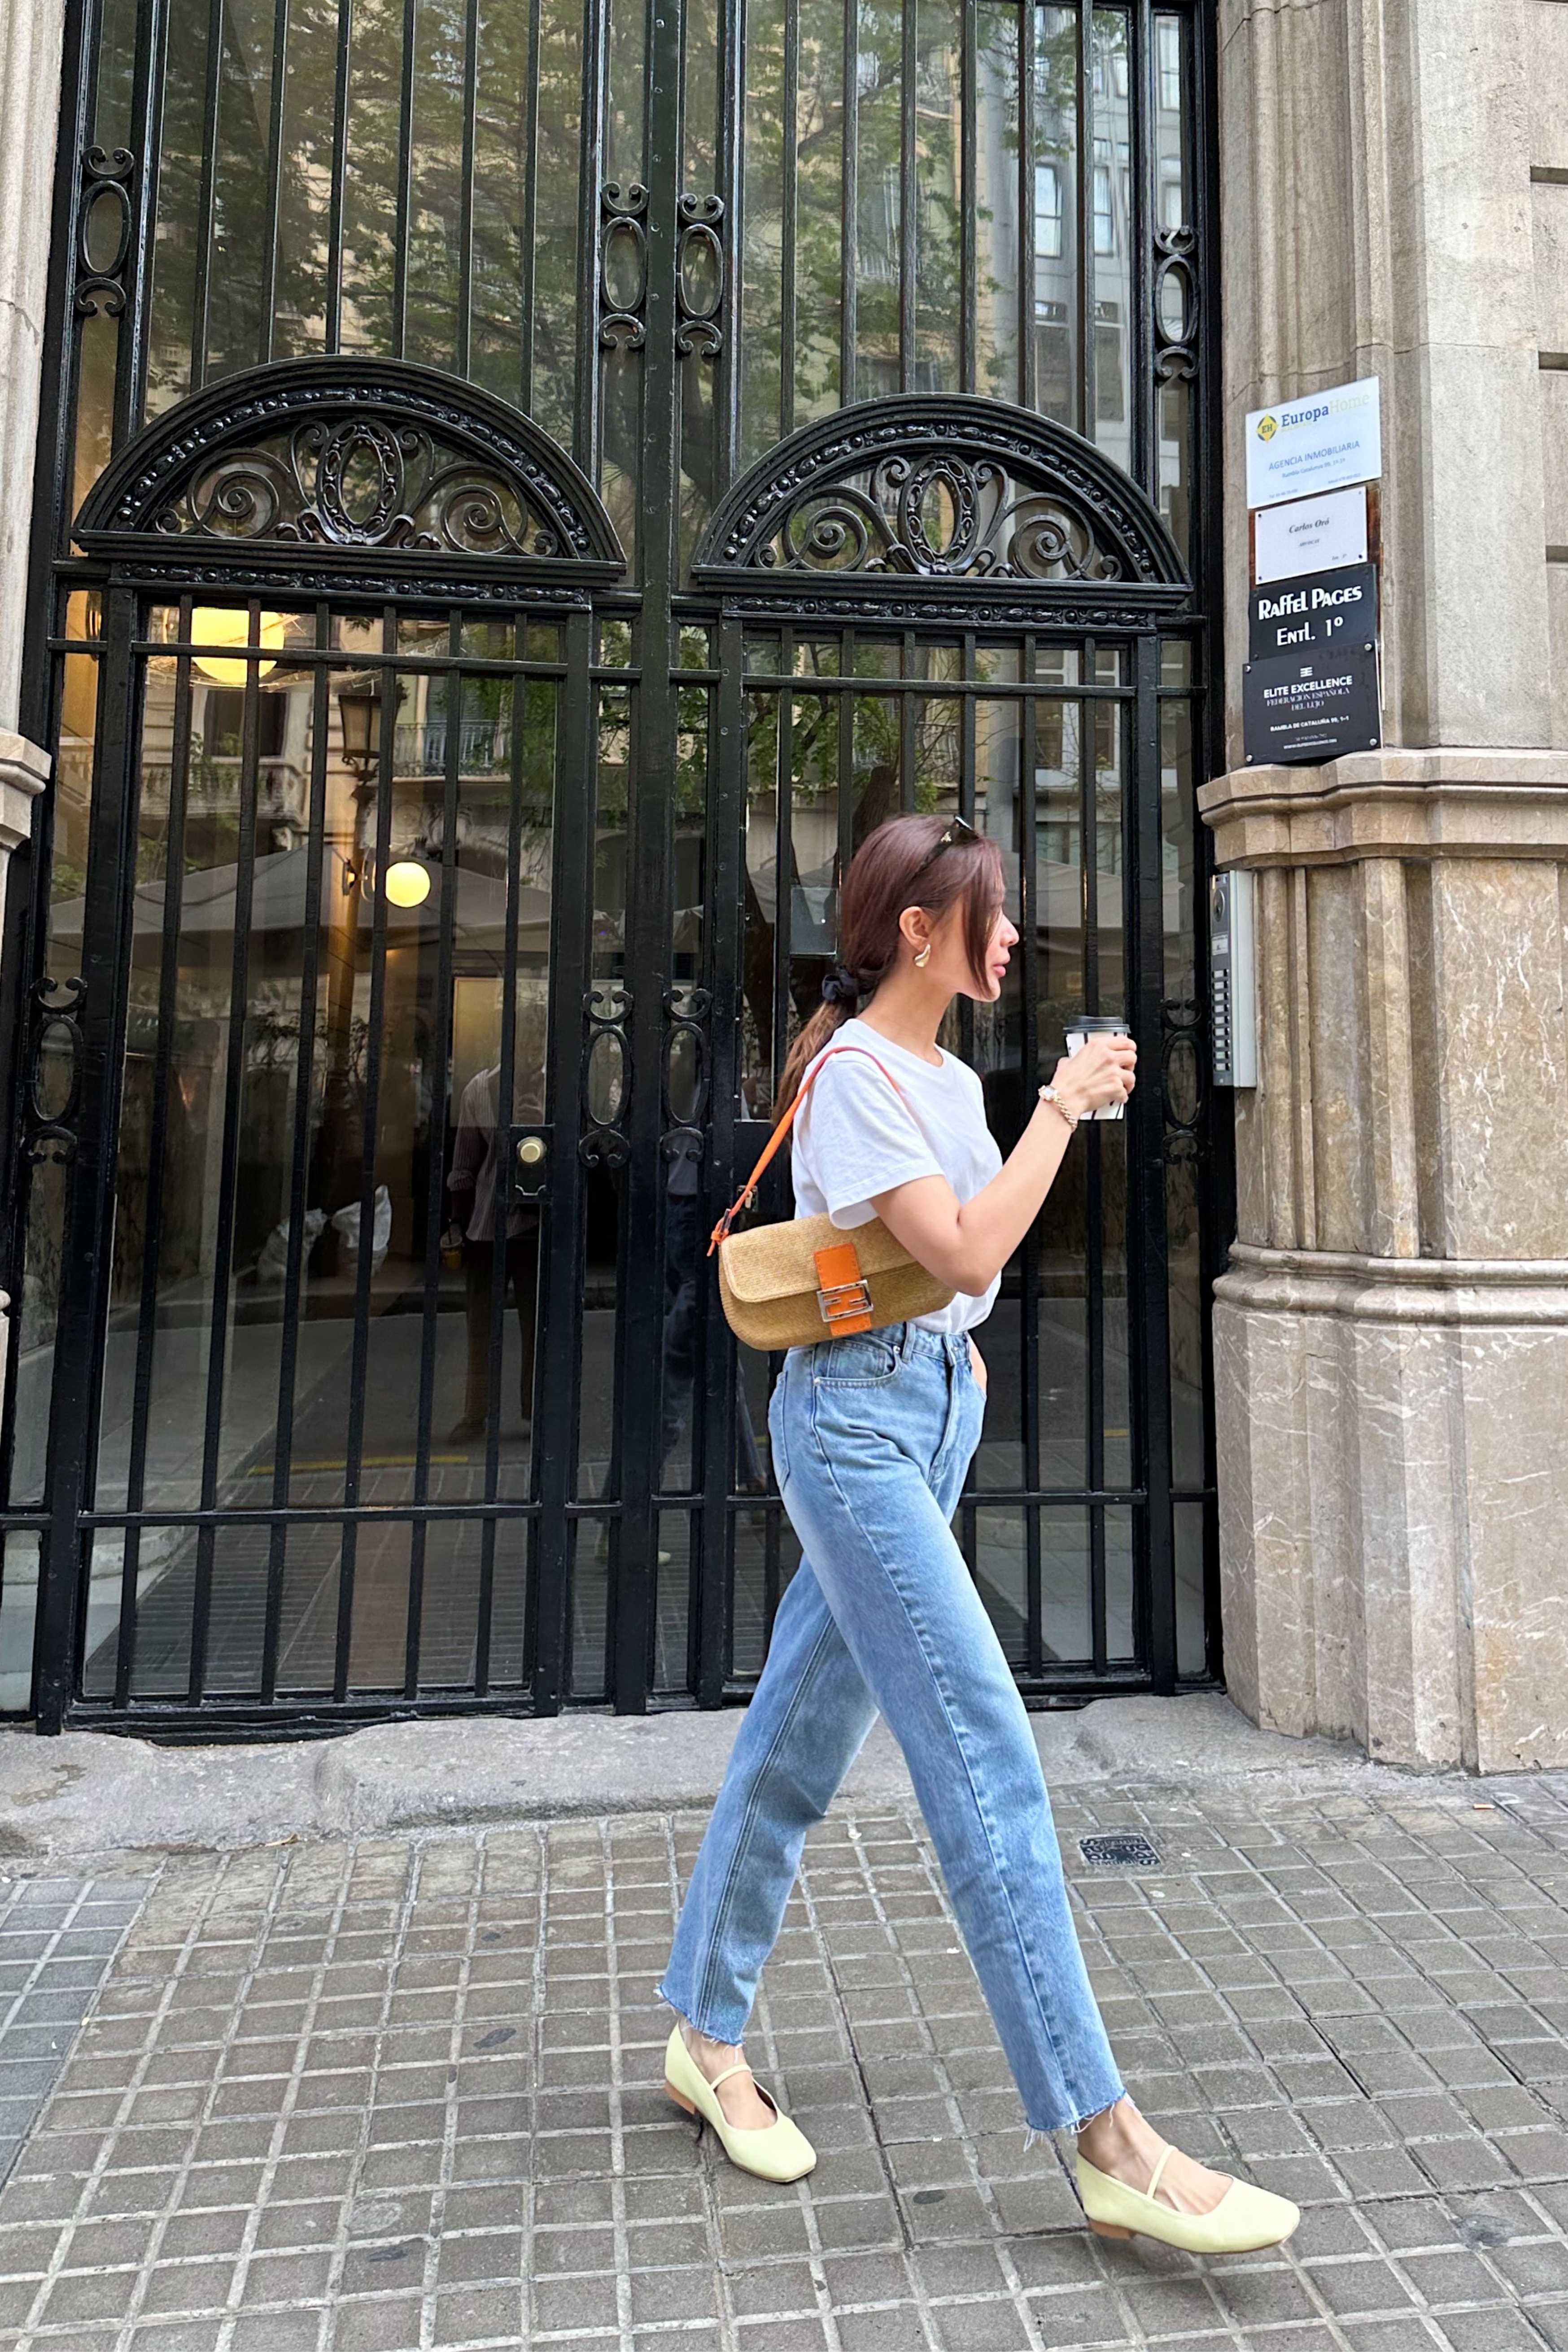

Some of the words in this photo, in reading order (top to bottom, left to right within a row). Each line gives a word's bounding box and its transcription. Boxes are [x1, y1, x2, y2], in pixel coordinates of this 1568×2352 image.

[1261, 424, 1273, 434] EH
[1269, 455, 1303, 470] AGENCIA
[1305, 440, 1360, 461] INMOBILIARIA
[1289, 523, 1313, 533] Carlos
[1263, 686, 1289, 699] ELITE
[1291, 675, 1352, 694] EXCELLENCE
